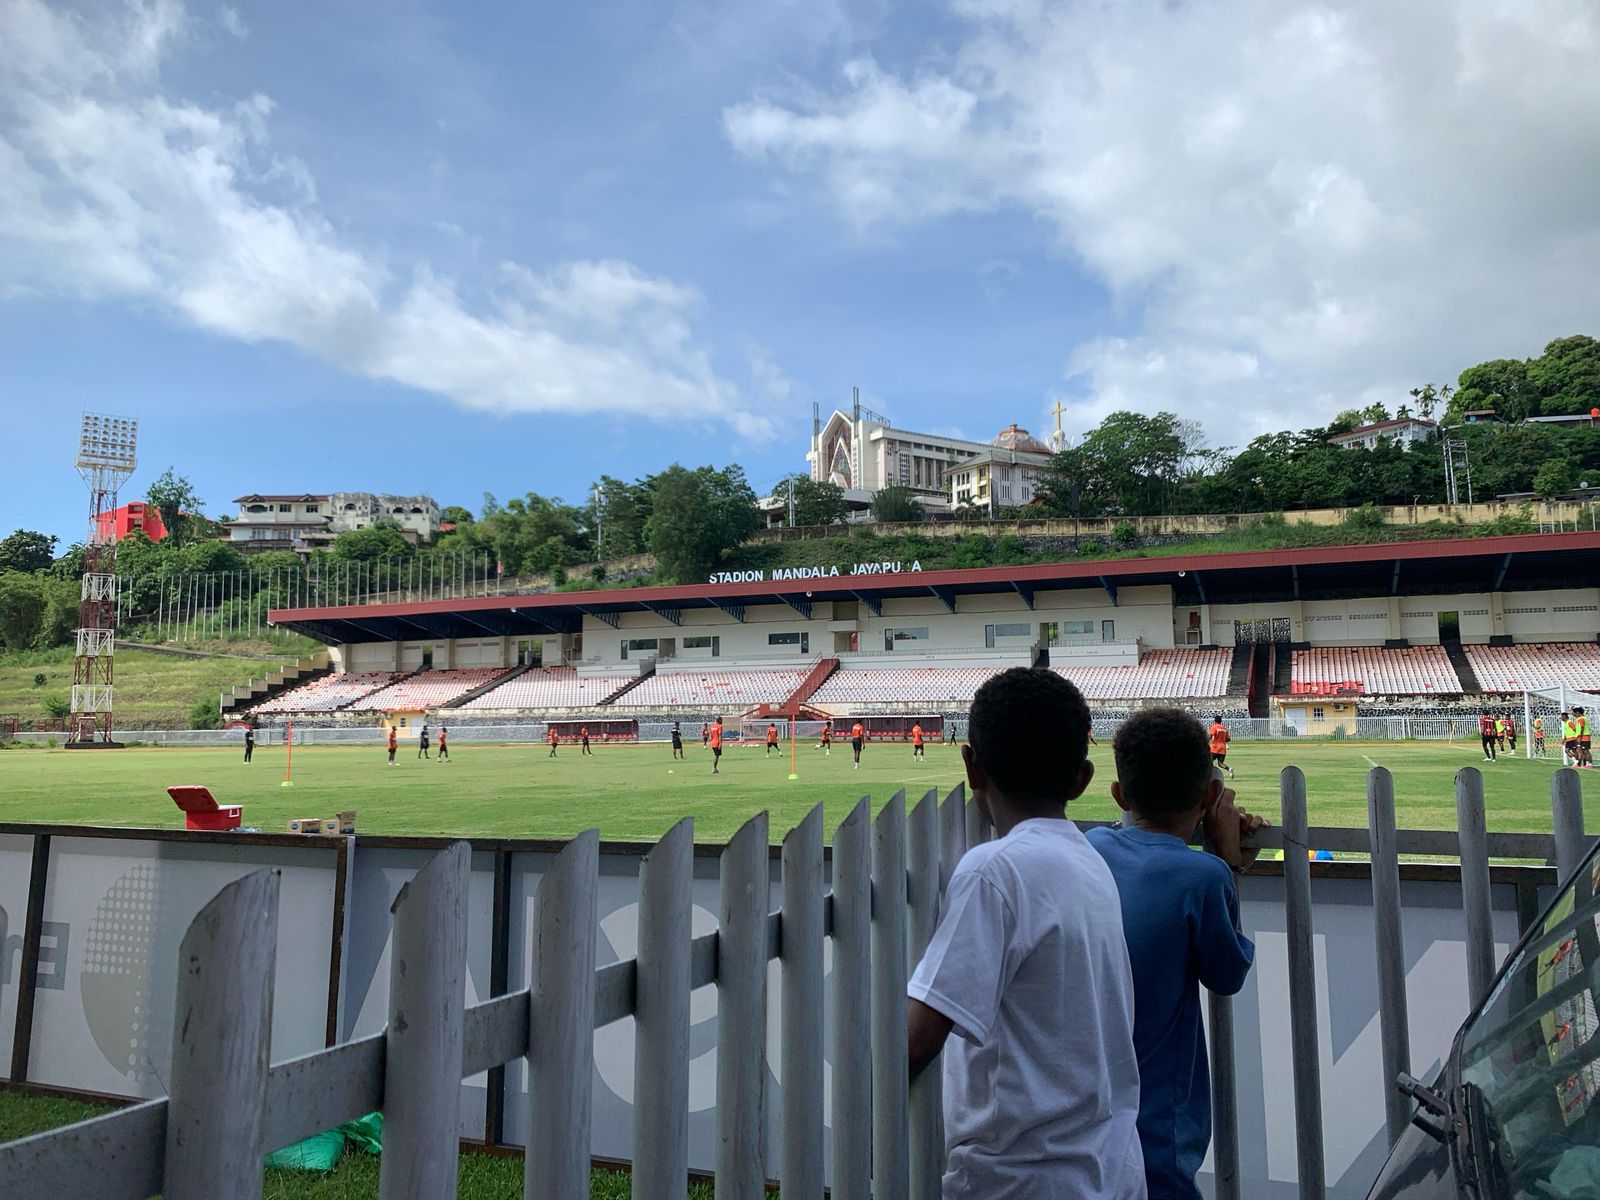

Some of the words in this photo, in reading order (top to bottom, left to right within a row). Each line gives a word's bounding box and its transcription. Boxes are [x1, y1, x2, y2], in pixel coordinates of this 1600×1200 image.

[708, 569, 764, 584] STADION
[772, 565, 840, 581] MANDALA
[850, 560, 922, 576] JAYAPUA
